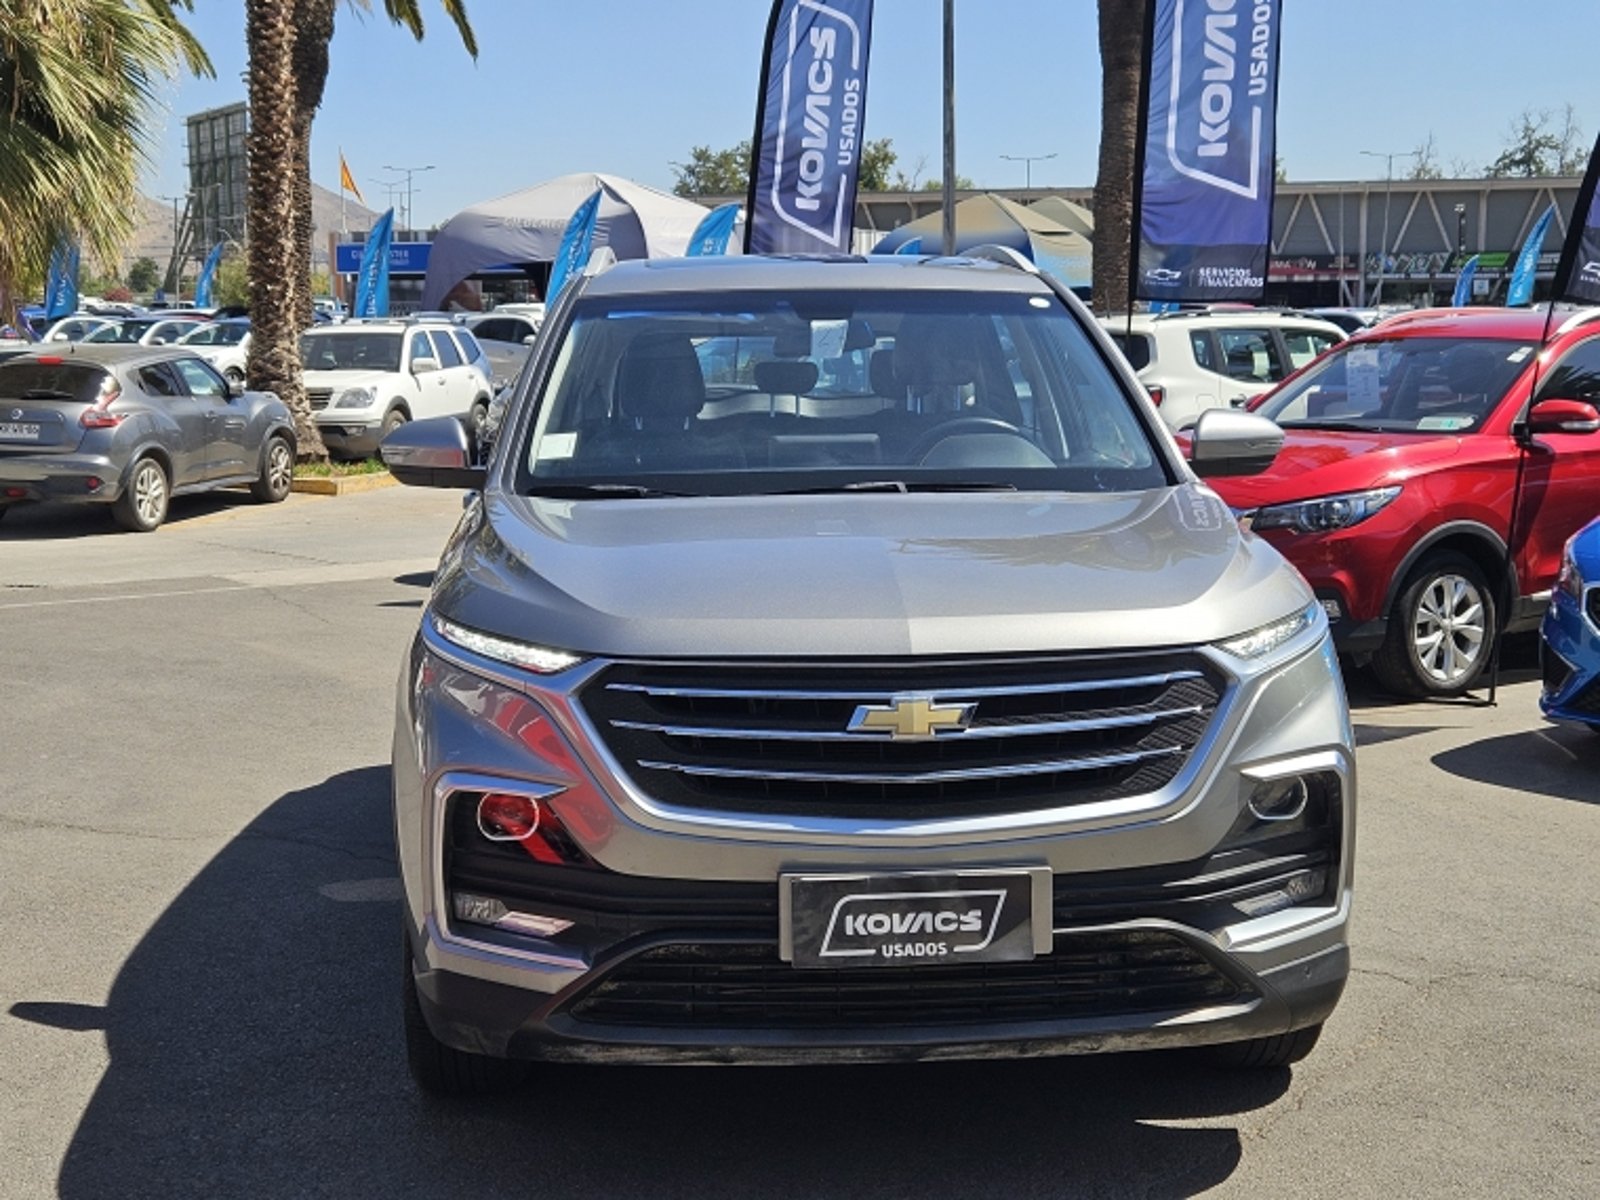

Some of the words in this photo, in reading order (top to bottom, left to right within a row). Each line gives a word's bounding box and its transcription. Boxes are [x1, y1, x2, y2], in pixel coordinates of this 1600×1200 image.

[795, 26, 836, 211] KOVACS
[837, 78, 860, 166] USADOS
[1198, 267, 1251, 277] SERVICIOS
[845, 909, 982, 936] KOVACS
[881, 942, 948, 959] USADOS
